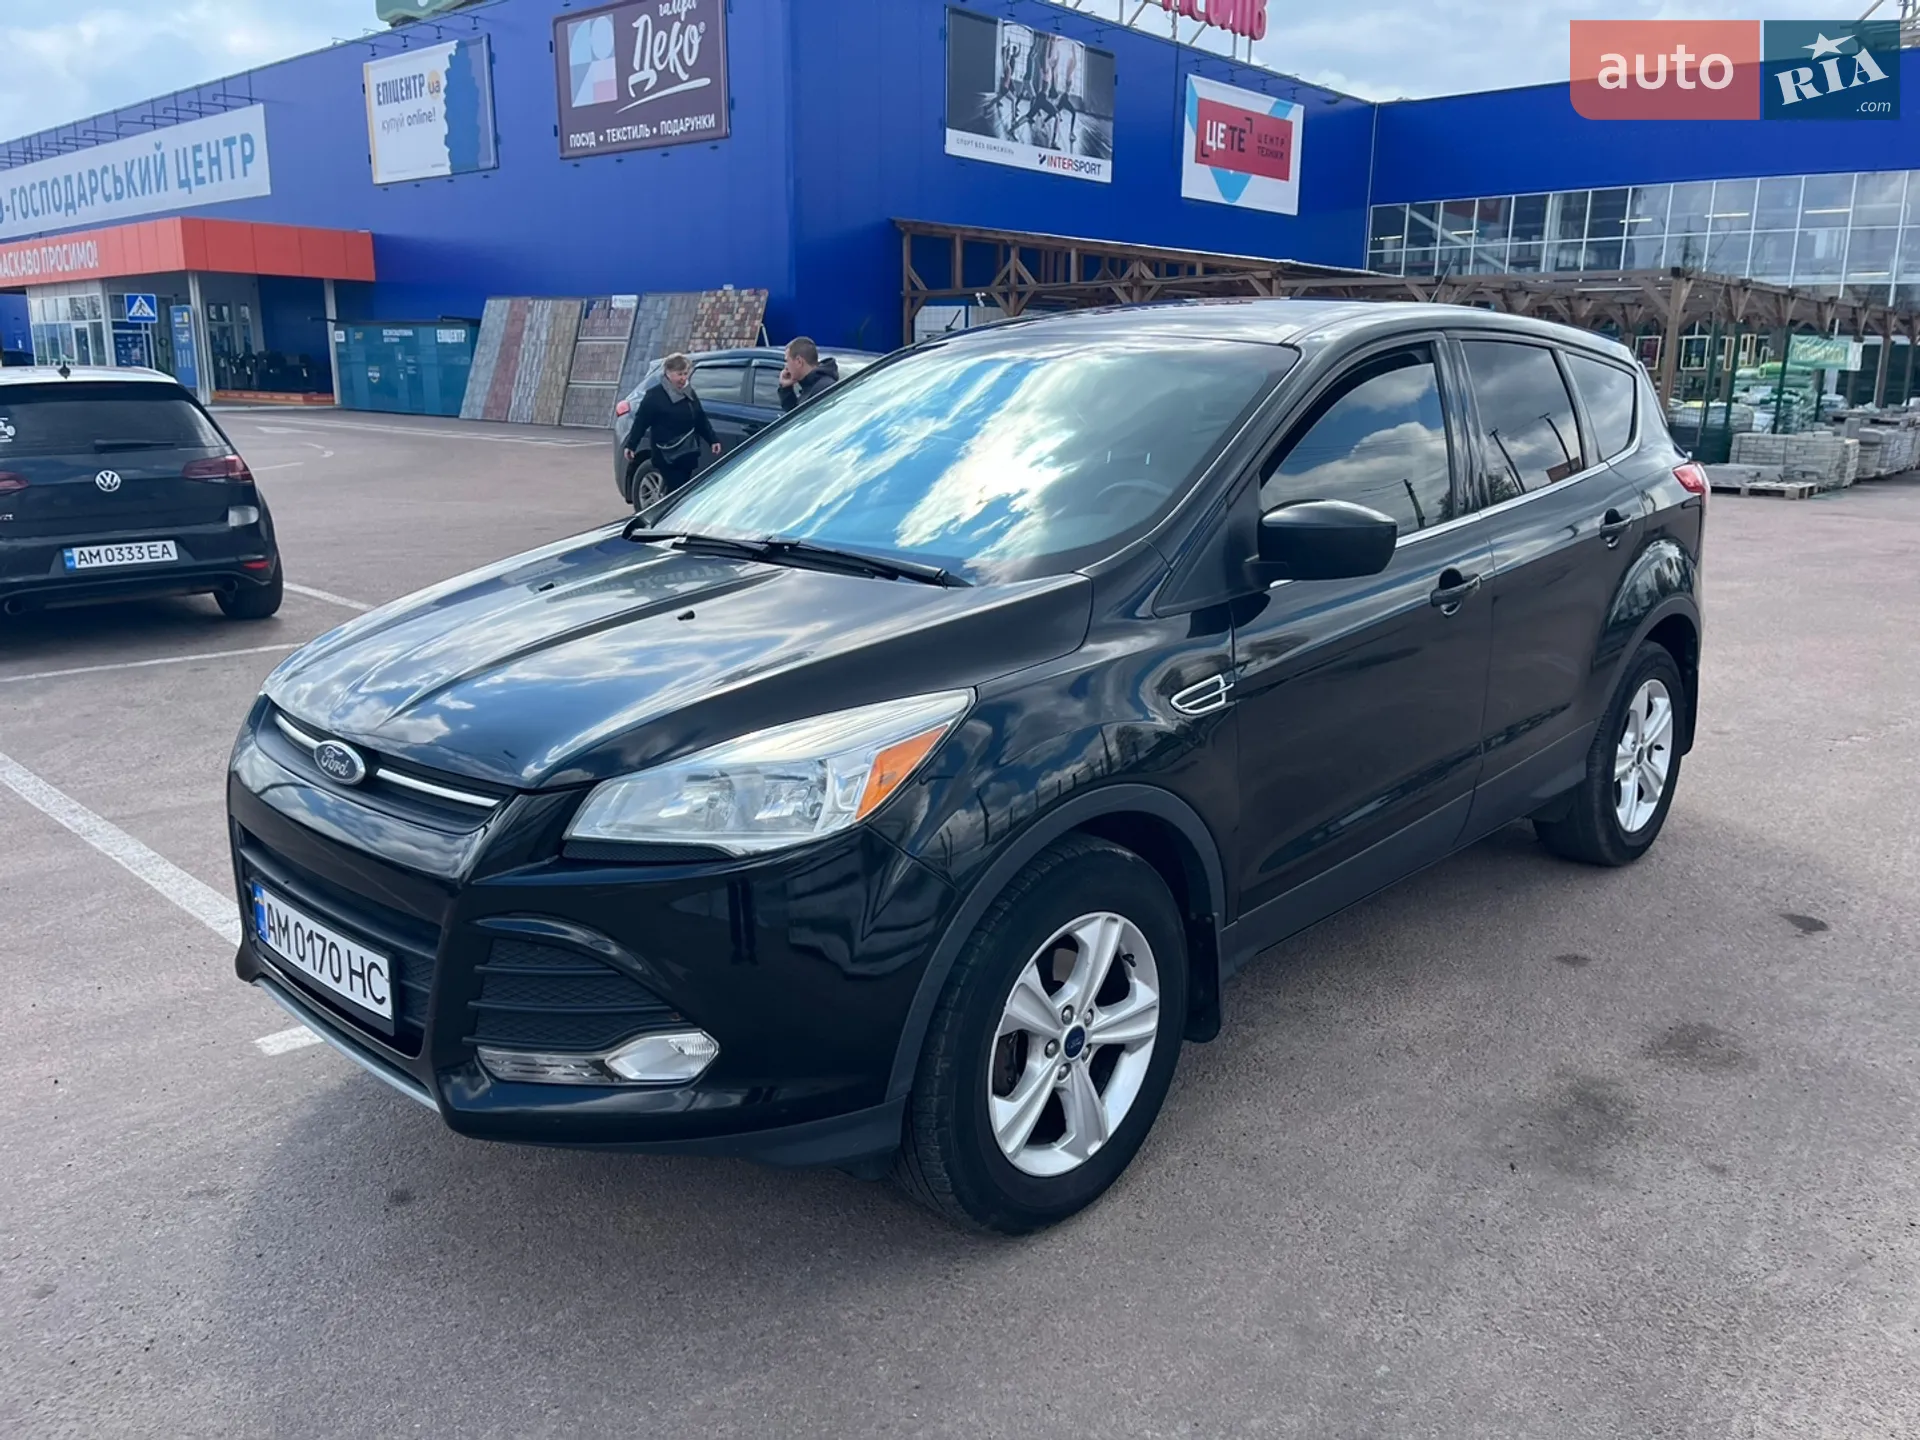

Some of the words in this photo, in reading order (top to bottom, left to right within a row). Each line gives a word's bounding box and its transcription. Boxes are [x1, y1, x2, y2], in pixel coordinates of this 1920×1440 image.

[569, 131, 597, 148] ПОСУД
[605, 123, 651, 143] ТЕКСТИЛЬ
[659, 113, 716, 136] ПОДАРУНКИ
[174, 132, 256, 194] ЦЕНТР
[1047, 156, 1102, 176] INTERSPORT
[41, 240, 98, 273] ПРОСИМО!
[77, 549, 103, 565] AM
[105, 546, 146, 563] 0333
[147, 544, 173, 559] EA
[320, 745, 350, 777] Ford
[266, 902, 291, 954] AM
[294, 921, 342, 984] 0170
[347, 949, 390, 1006] HC
